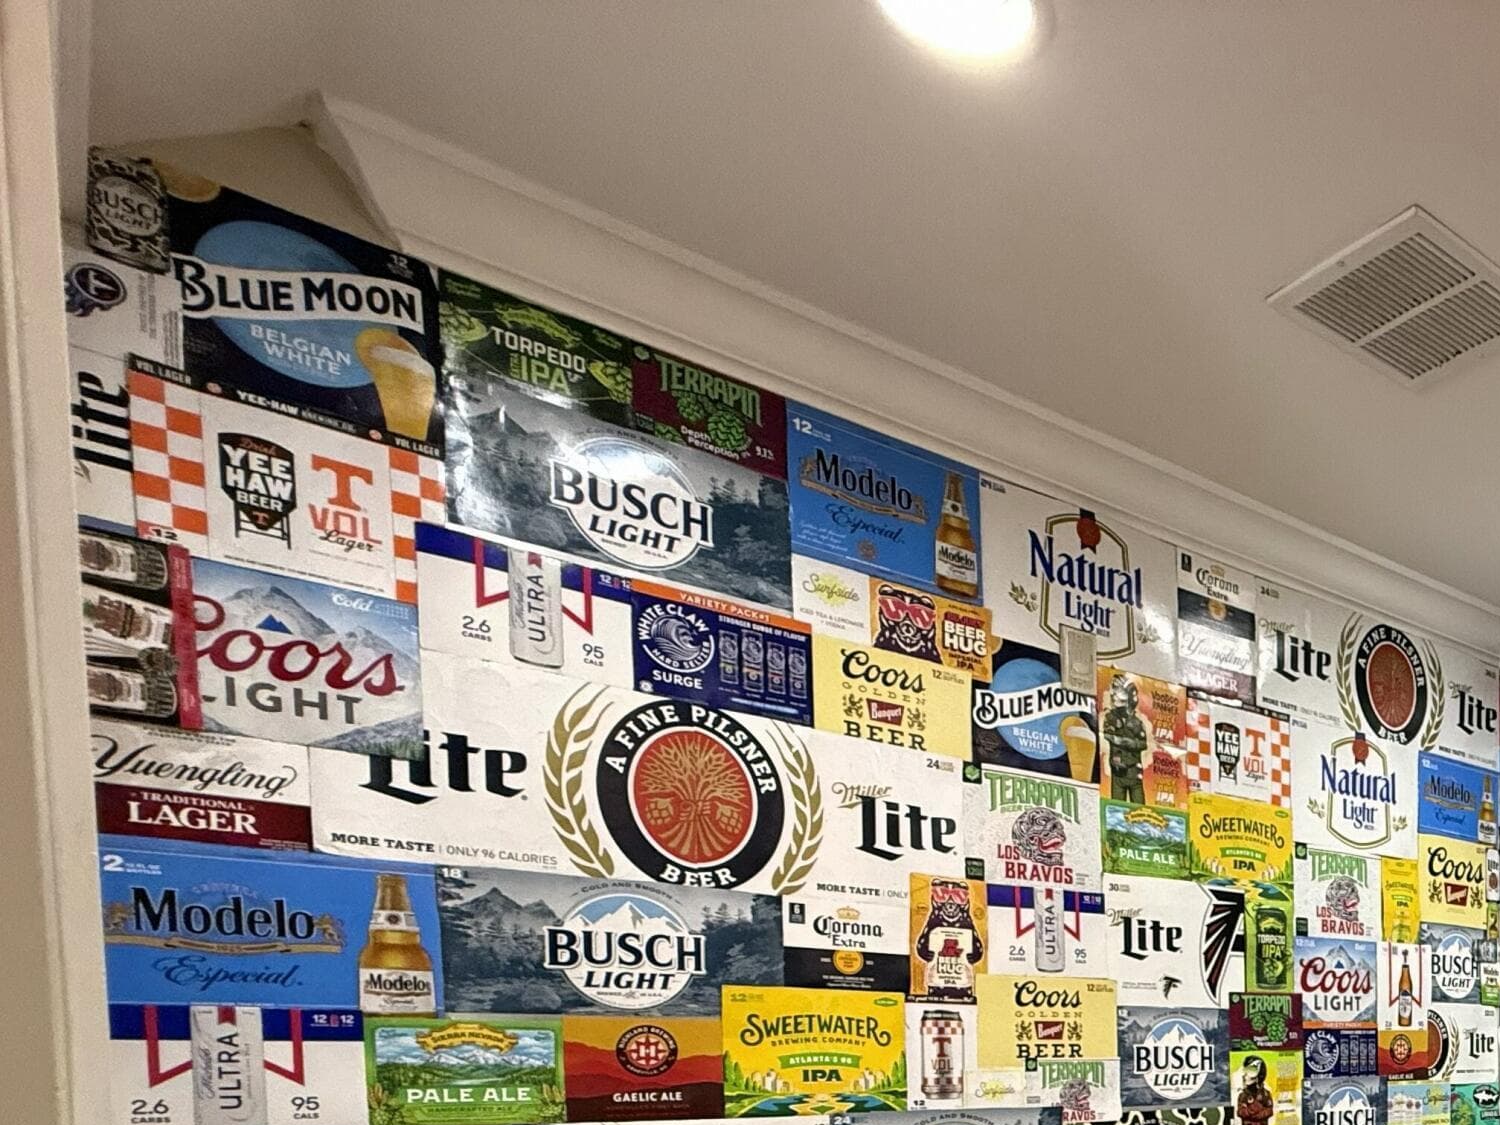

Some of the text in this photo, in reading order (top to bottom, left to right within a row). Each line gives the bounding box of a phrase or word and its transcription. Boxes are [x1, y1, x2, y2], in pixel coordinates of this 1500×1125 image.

[174, 257, 292, 316] BLUE
[304, 278, 419, 323] MOON
[249, 324, 352, 367] BELGIAN
[263, 342, 342, 376] WHITE
[491, 326, 586, 374] TORPEDO
[236, 391, 300, 416] YEE-HAW
[654, 354, 763, 428] TERRAPIN
[680, 424, 711, 444] Depth
[221, 444, 292, 480] YEE
[688, 436, 740, 461] Perception
[224, 467, 294, 500] HAW
[311, 453, 373, 511] T
[236, 491, 284, 512] BEER
[552, 461, 710, 542] BUSCH
[308, 503, 382, 545] VOL
[588, 514, 681, 553] LIGHT
[1028, 529, 1143, 609] Natural
[1196, 568, 1240, 595] Corona
[461, 631, 492, 642] CARBS
[944, 634, 988, 657] HUG
[582, 643, 605, 659] 95
[651, 669, 703, 690] SURGE
[840, 648, 926, 694] Coors
[842, 682, 926, 706] GOLDEN
[843, 720, 927, 751] BEER
[1018, 738, 1054, 752] WHITE
[1217, 729, 1239, 744] YEE
[1217, 740, 1239, 754] HAW
[91, 735, 298, 798] Yuengling
[1321, 754, 1397, 804] Natural
[141, 791, 246, 811] TRADITIONAL
[127, 801, 259, 835] LAGER
[1199, 813, 1285, 848] SWEETWATER
[331, 832, 558, 866] MORE TASTE ONLY 96 CALORIES
[1119, 848, 1176, 865] PALE ALE
[1005, 861, 1074, 885] BRAVOS
[1233, 859, 1256, 872] IPA
[129, 886, 315, 940] Modelo
[1316, 905, 1332, 918] LOS
[1321, 920, 1365, 936] BRAVOS
[153, 955, 296, 991] Especial
[1299, 956, 1374, 994] Coors
[1013, 980, 1083, 1008] Coors
[739, 1013, 891, 1046] SWEETWATER
[771, 1036, 866, 1047] BREWING COMPANY
[221, 1032, 242, 1111] ULTRA
[1136, 1046, 1213, 1073] BUSCH
[802, 1069, 842, 1082] IPA
[1154, 1074, 1199, 1086] LIGHT
[130, 1099, 169, 1115] 2.6
[291, 1096, 320, 1111] 95
[406, 1086, 532, 1103] PALE ALE
[612, 1091, 682, 1102] GAELIC ALE
[293, 1112, 320, 1120] CALS
